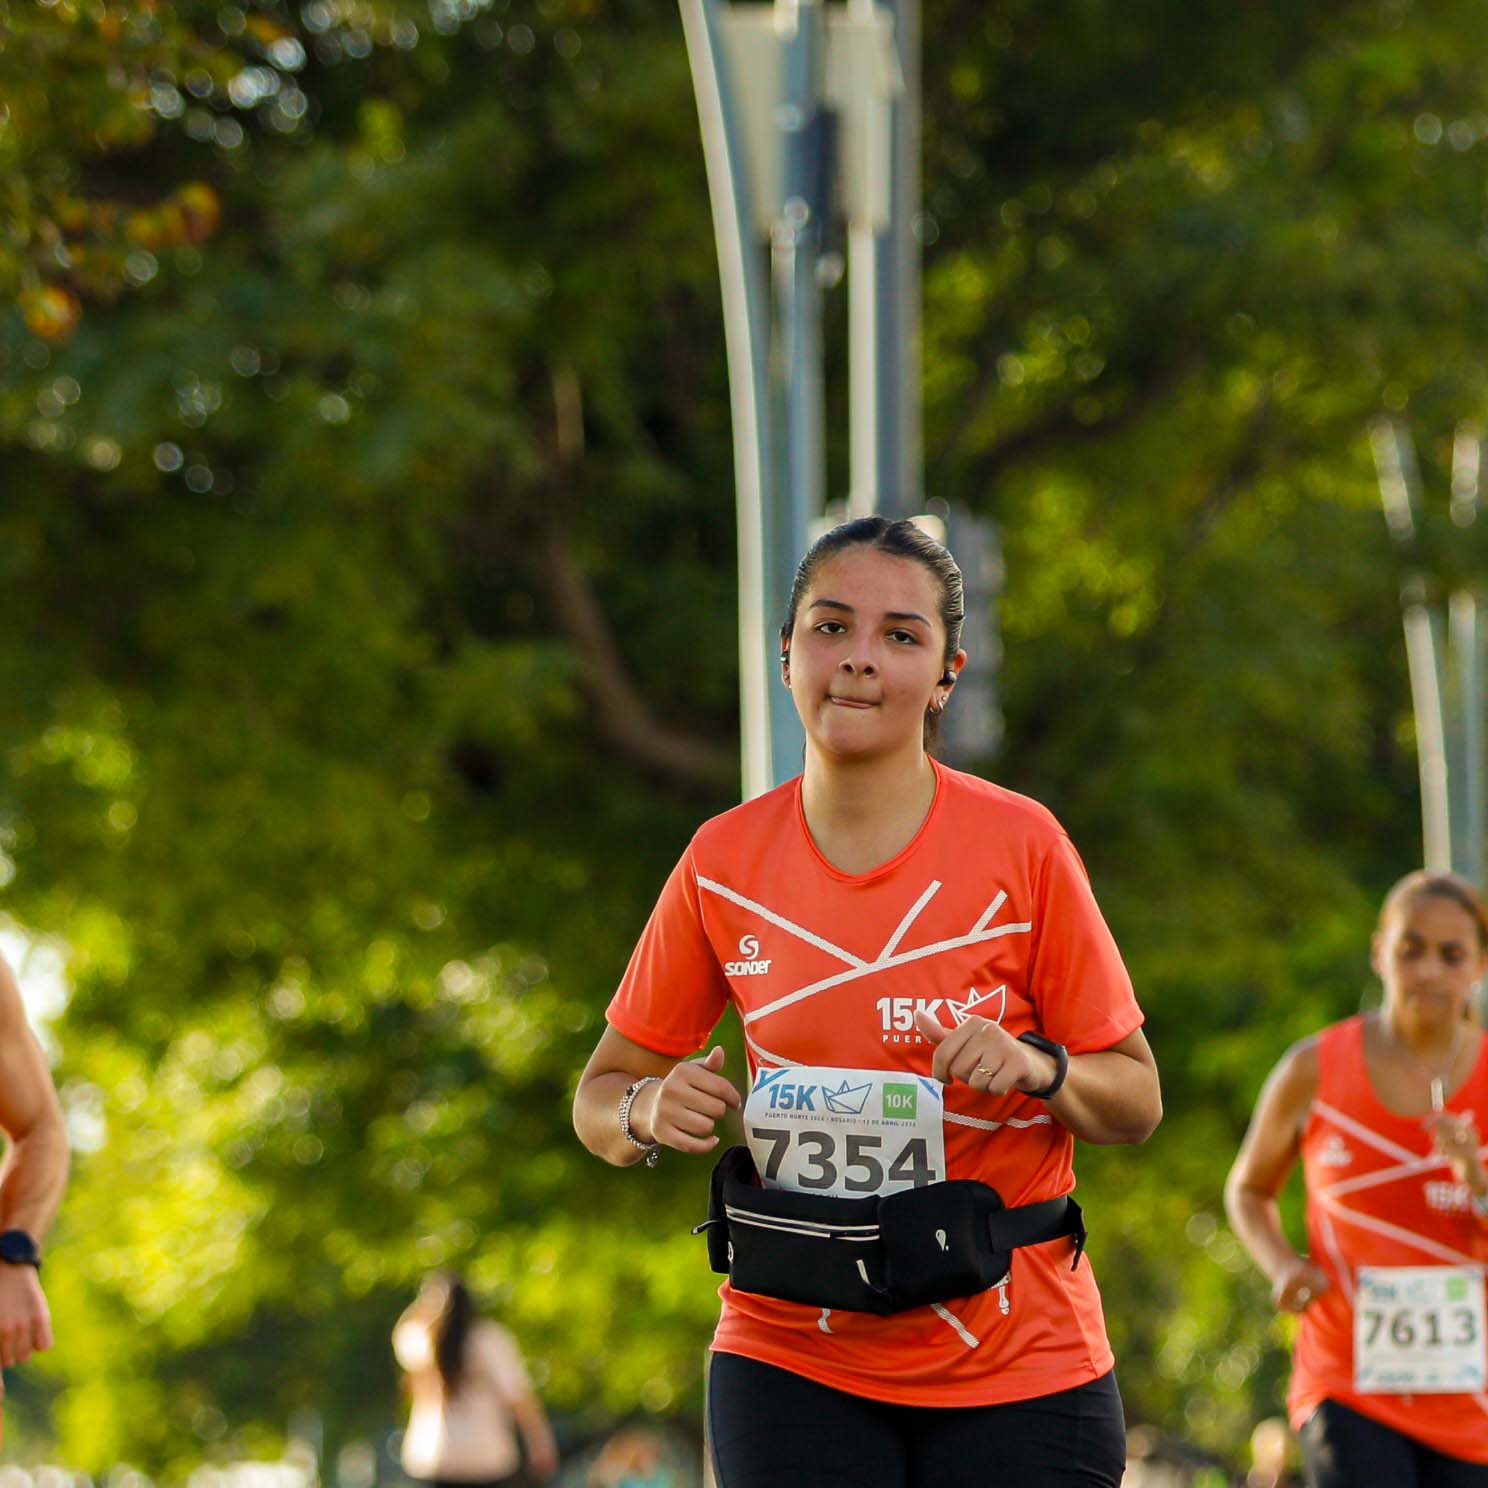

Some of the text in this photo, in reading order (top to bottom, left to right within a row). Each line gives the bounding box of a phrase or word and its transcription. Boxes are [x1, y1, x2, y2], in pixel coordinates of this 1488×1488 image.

[768, 1083, 817, 1112] 15K
[886, 1094, 913, 1108] 10K
[751, 1127, 937, 1192] 7354
[1364, 1308, 1478, 1348] 7613
